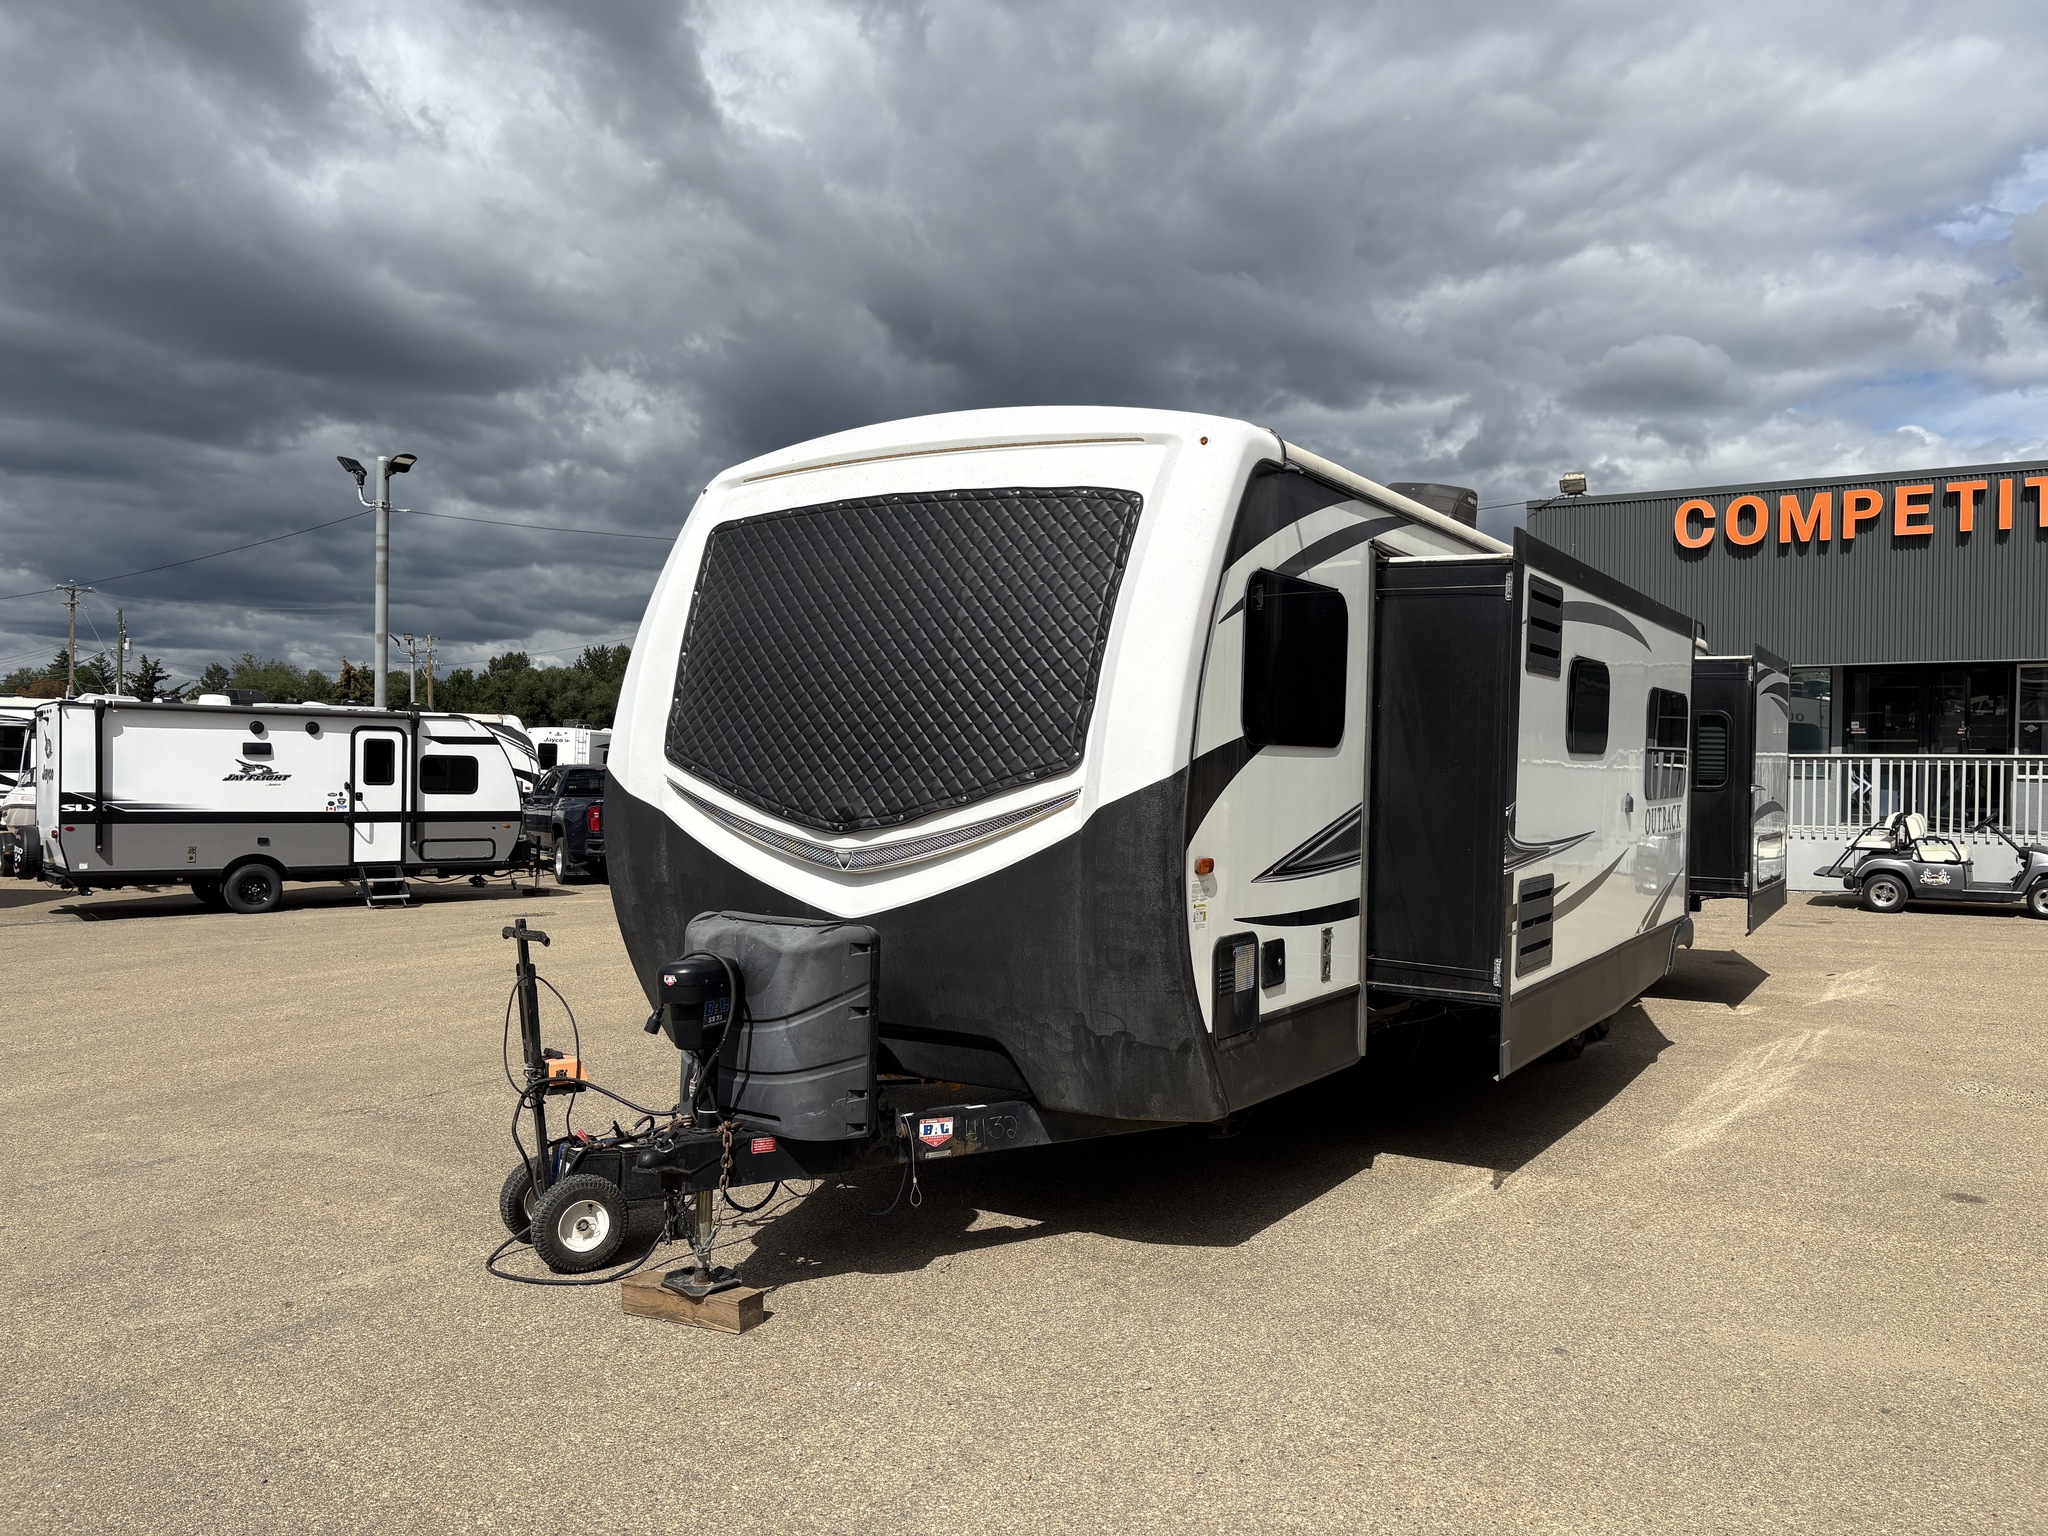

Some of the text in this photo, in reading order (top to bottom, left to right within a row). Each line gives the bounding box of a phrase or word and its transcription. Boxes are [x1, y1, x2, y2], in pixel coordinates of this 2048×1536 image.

[1674, 477, 2048, 548] COMPETIT
[42, 764, 54, 784] Jayco
[1645, 804, 1681, 835] OUTBACK
[923, 1123, 949, 1136] BAL
[965, 1116, 1020, 1143] 4132
